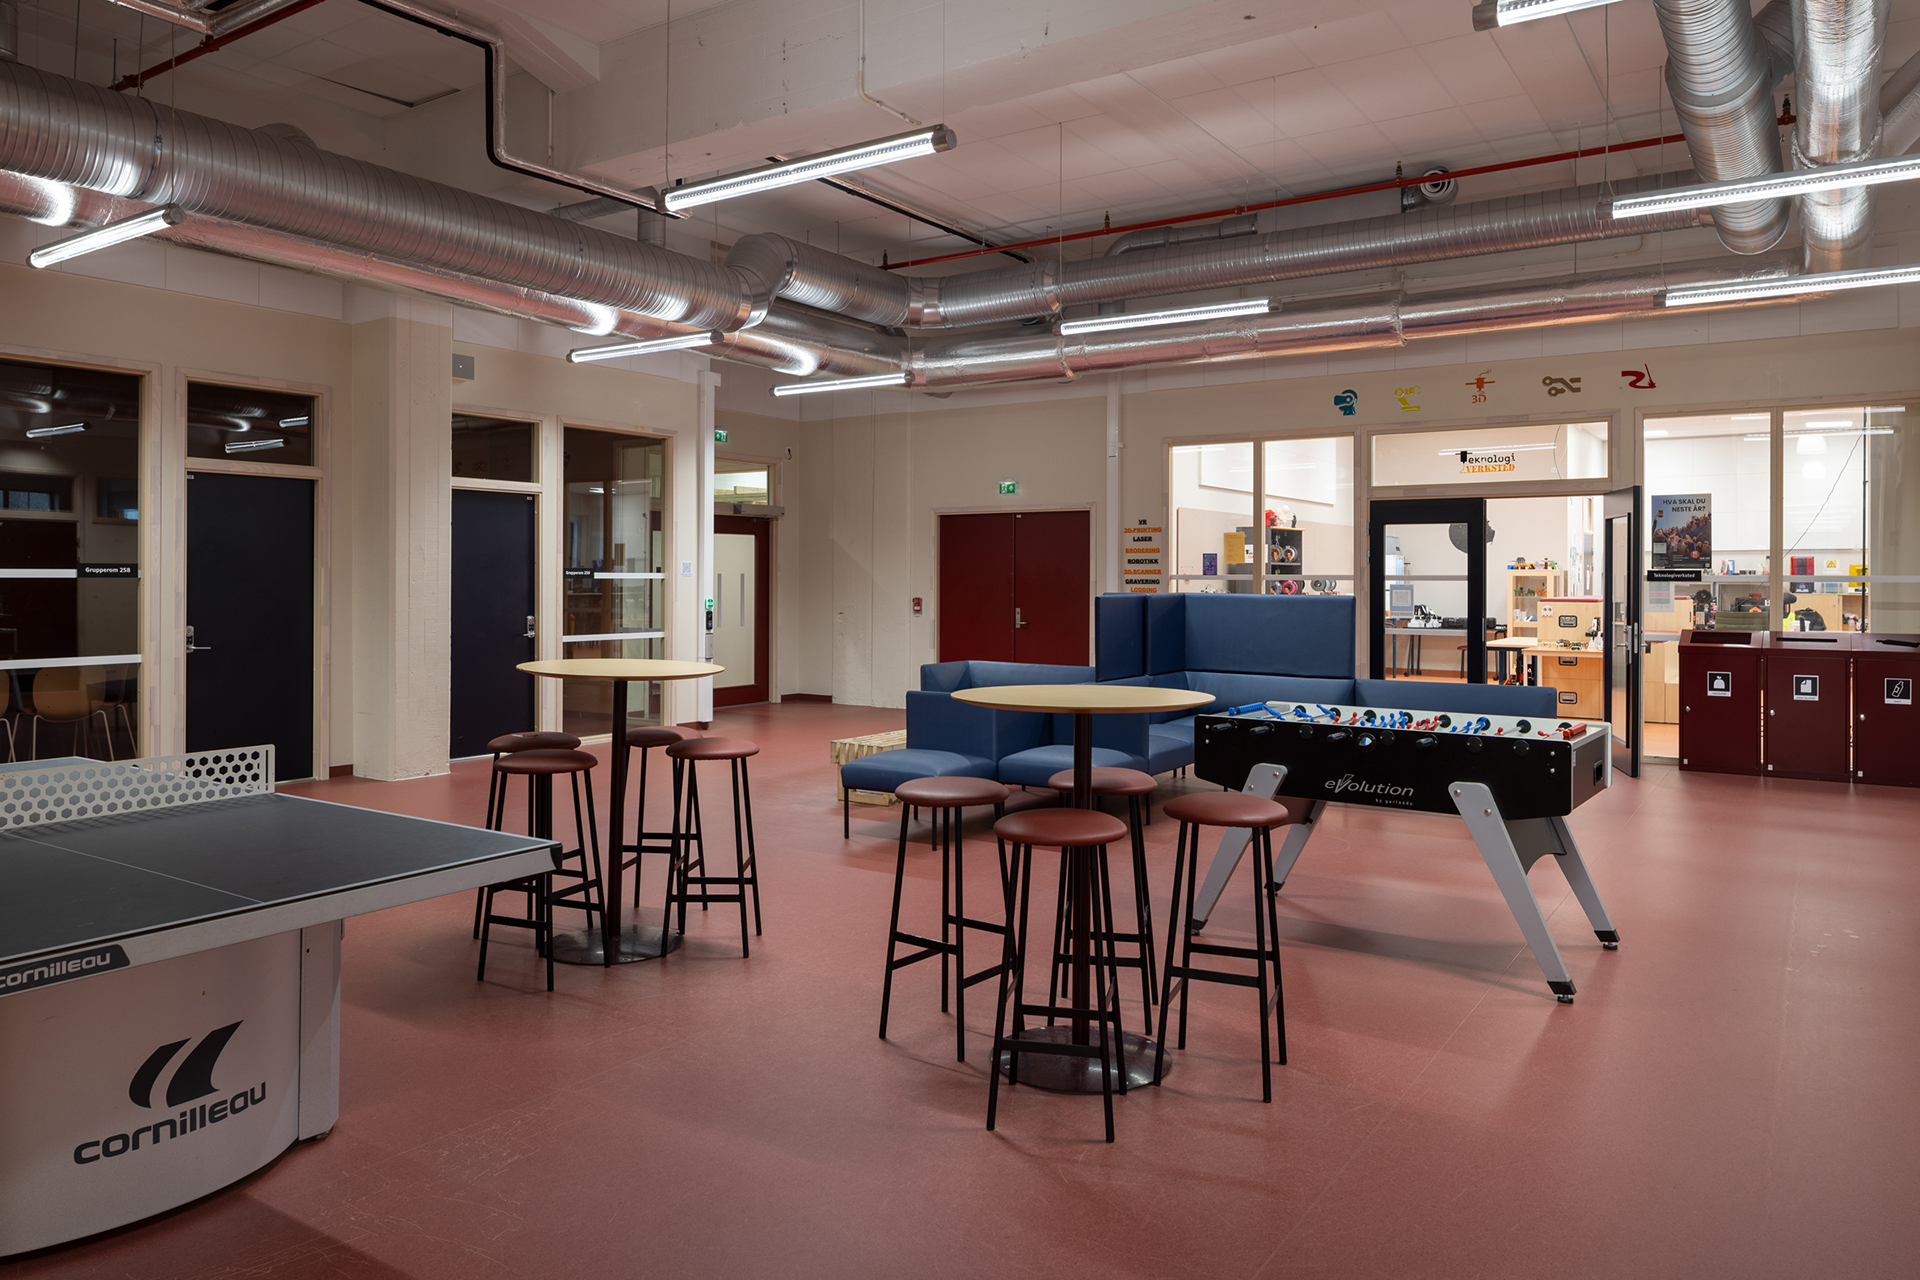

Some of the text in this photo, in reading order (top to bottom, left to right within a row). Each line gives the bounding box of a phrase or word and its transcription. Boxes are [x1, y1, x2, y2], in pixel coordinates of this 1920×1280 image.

[1471, 394, 1487, 404] 3D
[1465, 464, 1515, 473] VERKSTED
[73, 1081, 266, 1165] cornilleau
